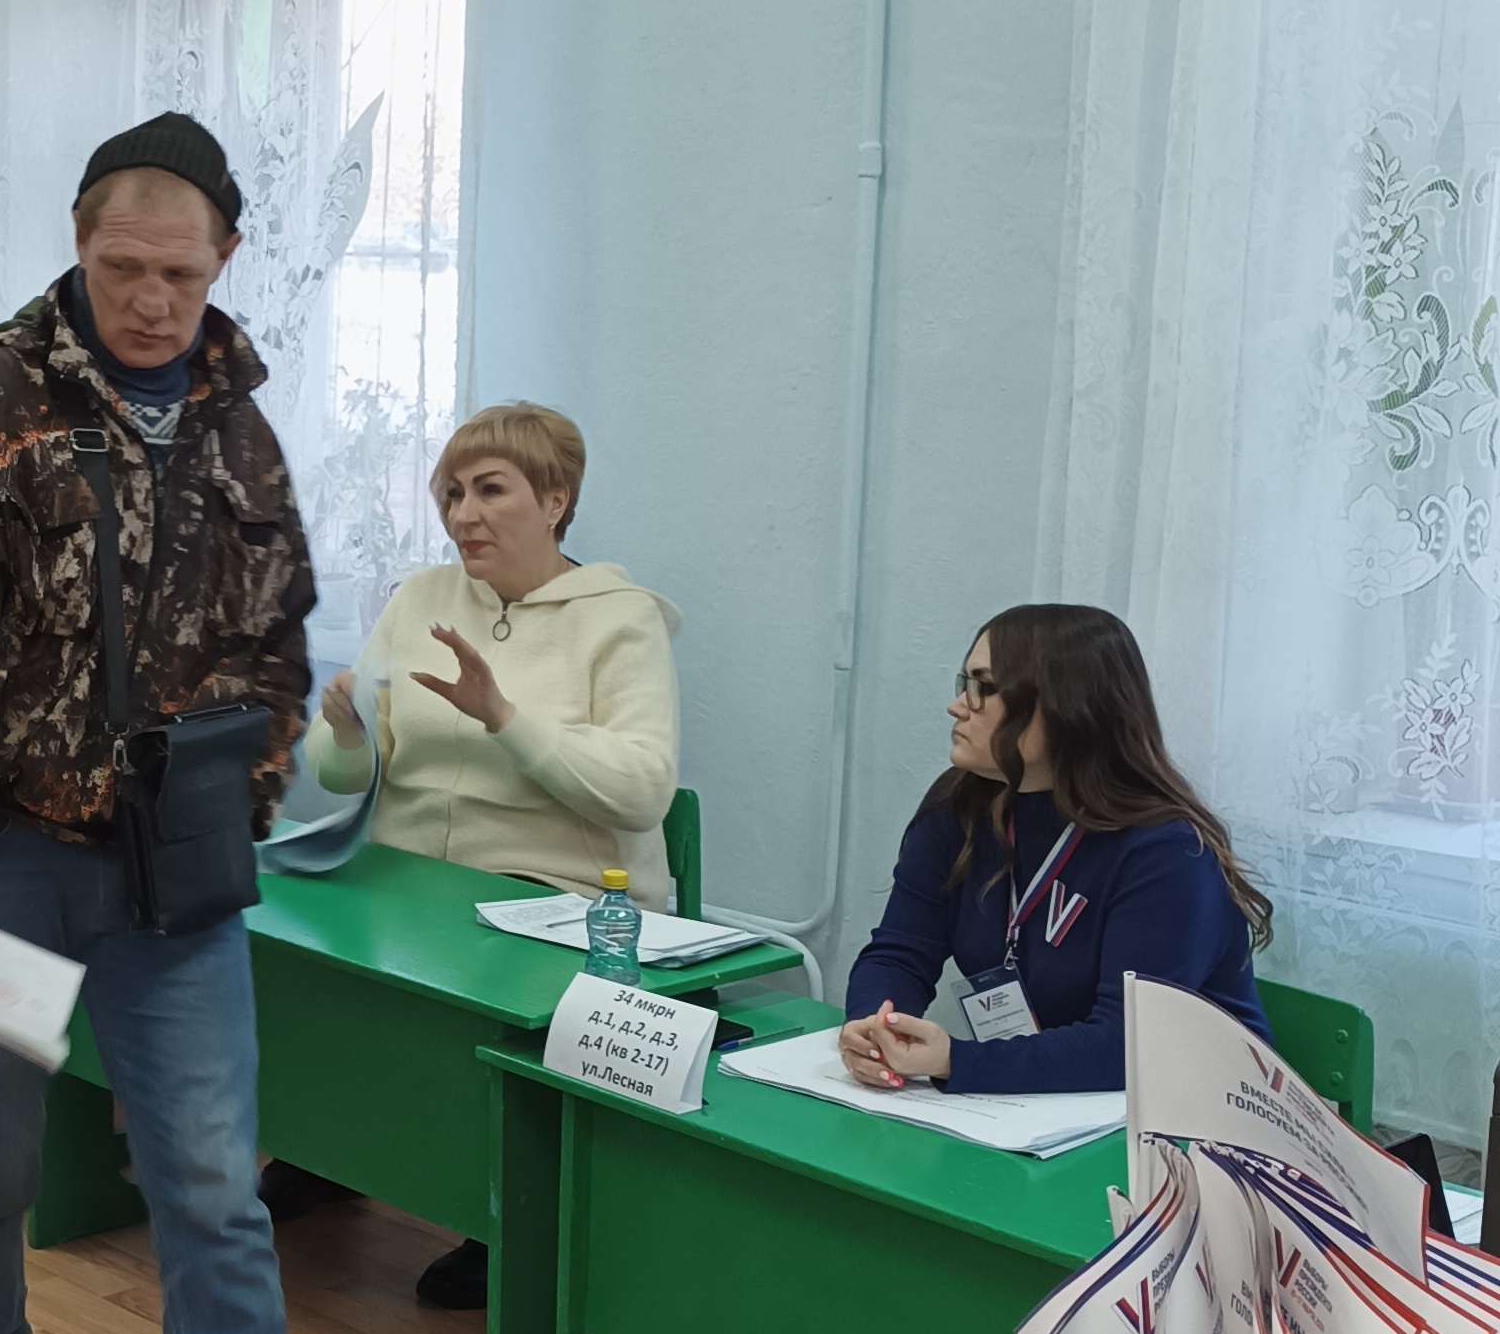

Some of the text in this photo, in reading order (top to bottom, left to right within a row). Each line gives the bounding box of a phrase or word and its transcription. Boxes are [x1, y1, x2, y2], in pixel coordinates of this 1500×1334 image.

[614, 989, 676, 1020] 34 мкрн
[588, 1010, 679, 1051] д.1, д.2, д.3,
[578, 1034, 670, 1077] д.4 (кв 2-17)
[581, 1061, 654, 1097] ул.Лесная
[1226, 1092, 1302, 1144] ГОЛОСУЕМ
[1240, 1080, 1293, 1123] ВМЕСТЕ
